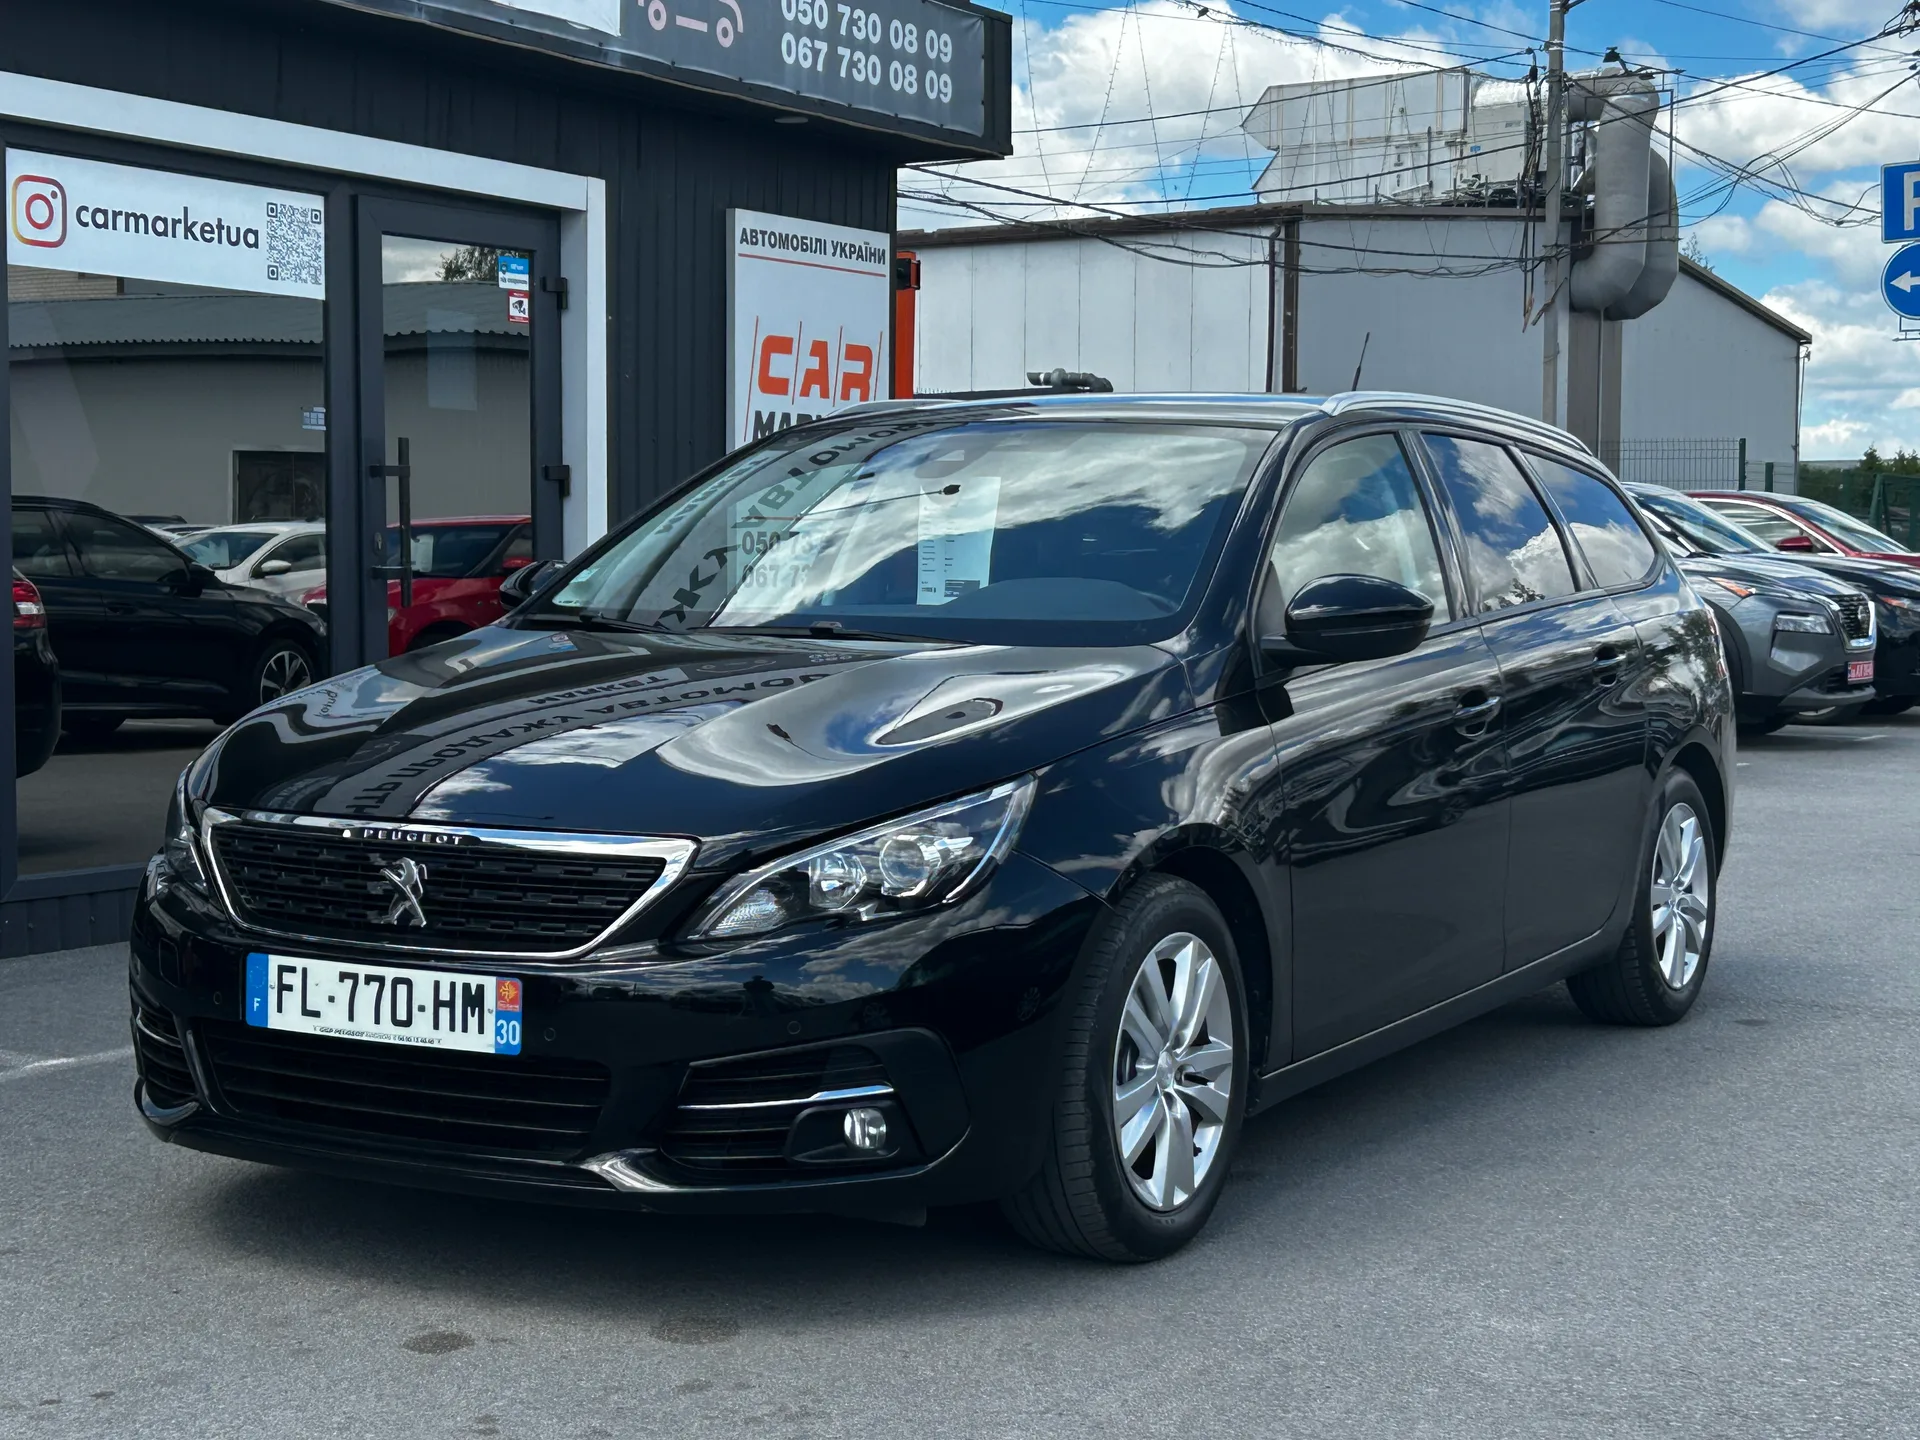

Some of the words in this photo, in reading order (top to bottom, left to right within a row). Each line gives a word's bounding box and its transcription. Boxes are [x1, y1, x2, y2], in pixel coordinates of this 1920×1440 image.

[781, 0, 828, 30] 050
[837, 3, 881, 44] 730
[889, 19, 918, 54] 08
[925, 29, 952, 63] 09
[781, 32, 828, 72] 067
[837, 46, 881, 86] 730
[889, 60, 918, 95] 08
[925, 69, 952, 104] 09
[75, 205, 259, 249] carmarketua
[739, 227, 827, 254] АВТОМОБІЛІ
[831, 240, 886, 265] УКРАЇНИ
[757, 334, 873, 402] CAR
[363, 829, 463, 845] PEUGEOT
[253, 997, 260, 1012] F
[496, 1019, 520, 1046] 30
